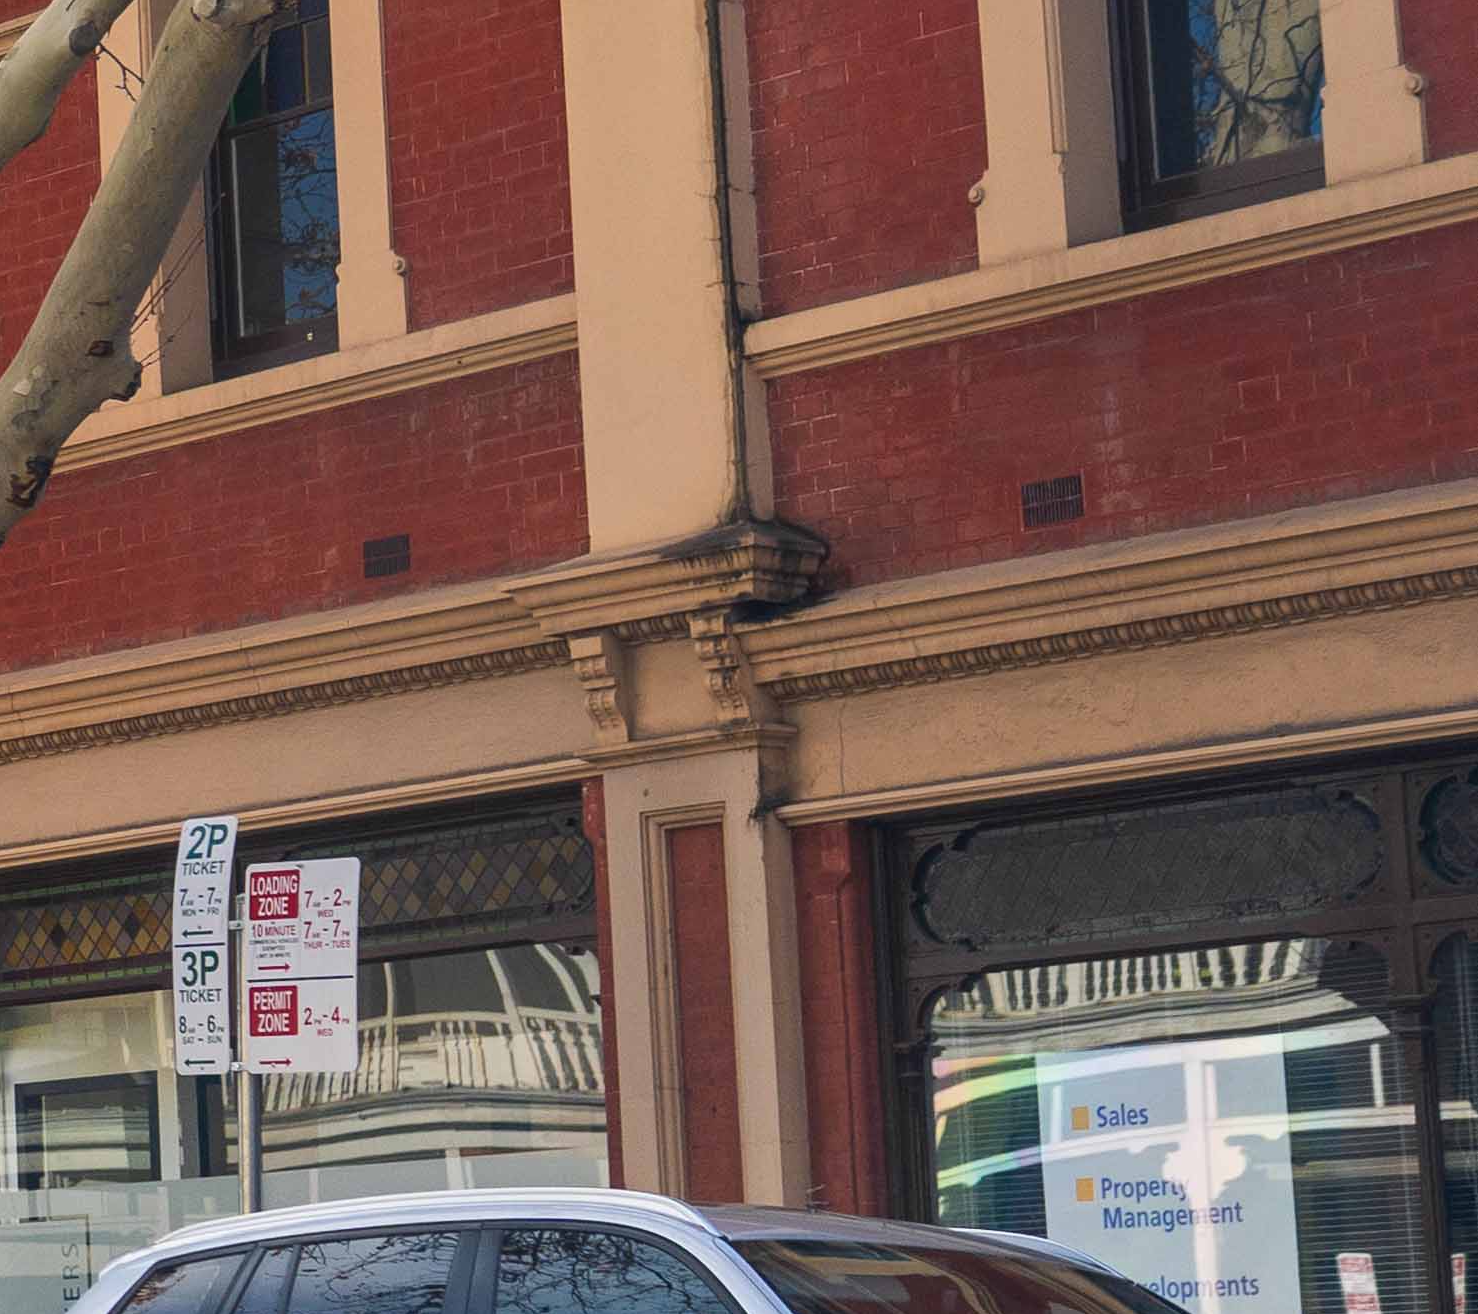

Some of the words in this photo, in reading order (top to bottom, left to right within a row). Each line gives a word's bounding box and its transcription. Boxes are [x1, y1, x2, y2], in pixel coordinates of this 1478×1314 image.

[185, 823, 229, 860] 2P
[181, 860, 226, 876] TICKET
[250, 875, 298, 896] LOADING
[257, 896, 290, 917] ZONE
[252, 924, 263, 938] 10
[264, 924, 297, 937] MINUTE
[181, 950, 220, 988] 3P
[179, 988, 222, 1003] TICKET
[253, 990, 294, 1011] PERMIT
[257, 1012, 290, 1033] ZONE
[1096, 1103, 1149, 1128] Sales
[1100, 1177, 1189, 1203] Property
[1102, 1200, 1244, 1233] Management
[62, 1242, 82, 1302] ERS
[1139, 1274, 1260, 1304] elopments
